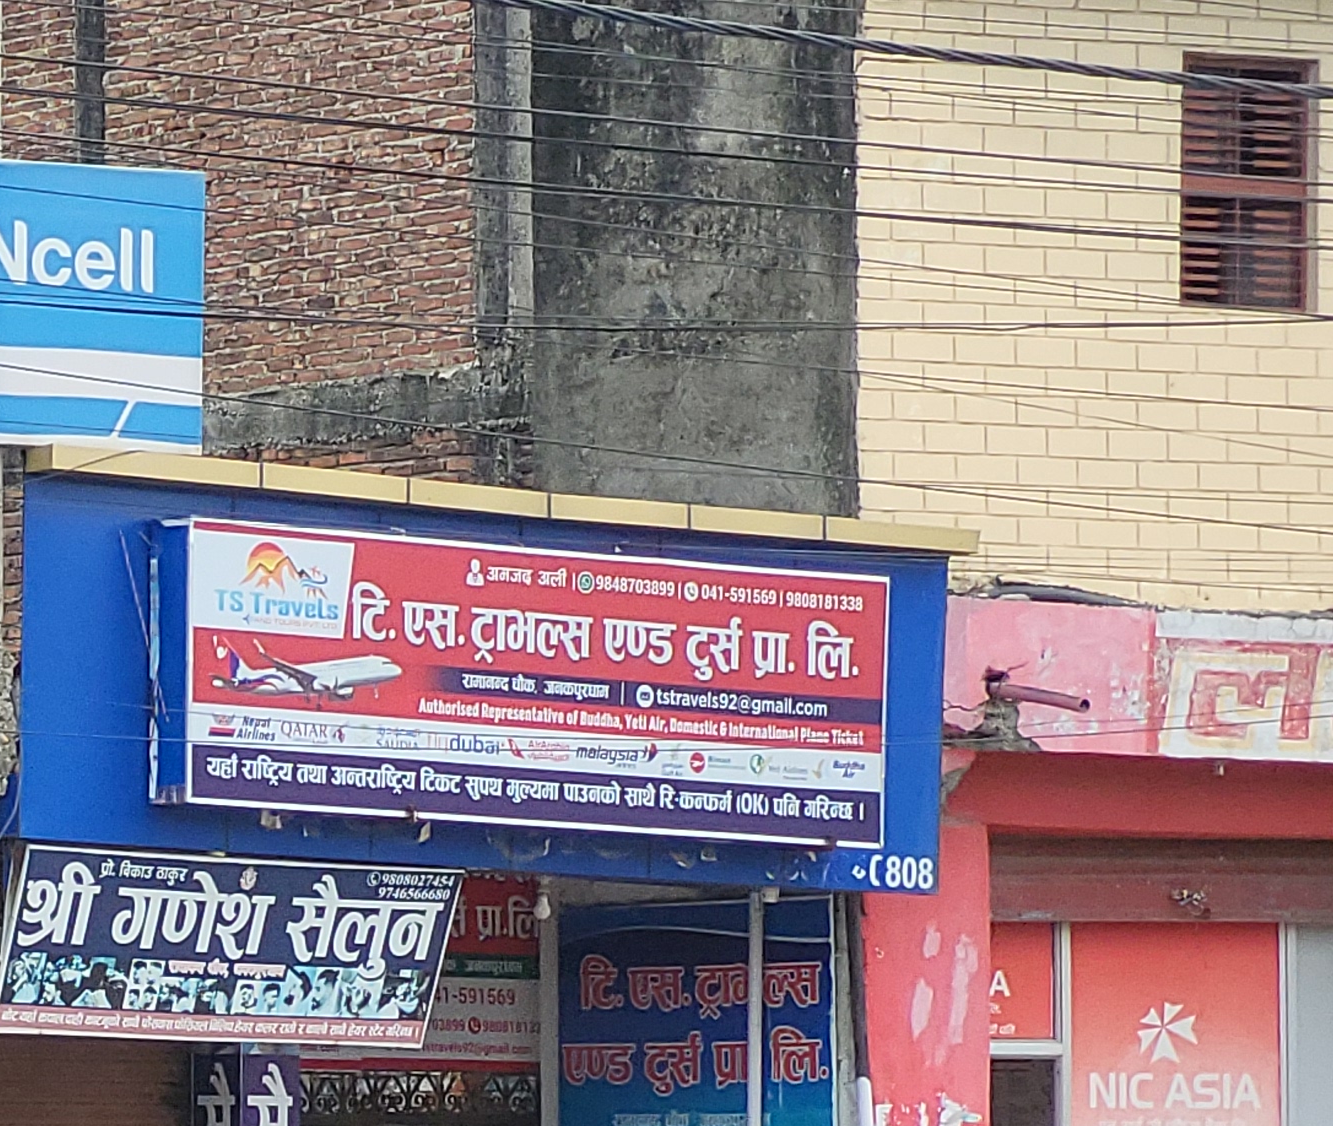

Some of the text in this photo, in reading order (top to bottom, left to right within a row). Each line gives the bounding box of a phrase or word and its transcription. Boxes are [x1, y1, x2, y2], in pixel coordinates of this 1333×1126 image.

[212, 588, 340, 622] TS Travels
[537, 567, 864, 612] अली 9848703899 041-591569 9808181338
[351, 581, 397, 641] टि.
[470, 605, 594, 665] ट्राभल्स
[602, 617, 678, 666] एण्ड
[685, 616, 743, 682] टुर्स
[751, 627, 796, 679] प्रा.
[805, 618, 860, 679] लि.
[241, 715, 272, 730] Nepal
[418, 697, 480, 718] Authorised
[481, 702, 564, 724] Representative
[565, 708, 579, 725] of
[624, 712, 647, 731] Yeti
[668, 716, 719, 737] Domestic
[728, 721, 799, 743] International
[655, 689, 828, 718] tstravels92@gmail.com
[236, 720, 640, 767] Airlines QATAR malaysia
[205, 752, 238, 779] यहाँ
[240, 754, 294, 787] राष्ट्रिय
[295, 762, 328, 785] तथा
[329, 762, 417, 796] अन्तराष्ट्रिय
[419, 766, 462, 794] टिकट
[464, 774, 503, 802] सुपथ
[562, 779, 623, 808] पाउनको
[735, 792, 770, 817] (OK)
[772, 794, 801, 818] पनि
[803, 794, 855, 822] गरिन्छ
[841, 768, 857, 780] Air
[377, 886, 451, 901] 9746566680
[380, 872, 456, 888] 9808027454
[15, 861, 102, 947] श्री
[110, 871, 276, 961] गणेश
[284, 873, 445, 981] सैलुन
[579, 953, 624, 1010] टि.
[562, 1024, 830, 1097] एण्ड टुर्स लि.
[1088, 1071, 1262, 1112] NIC ASIA
